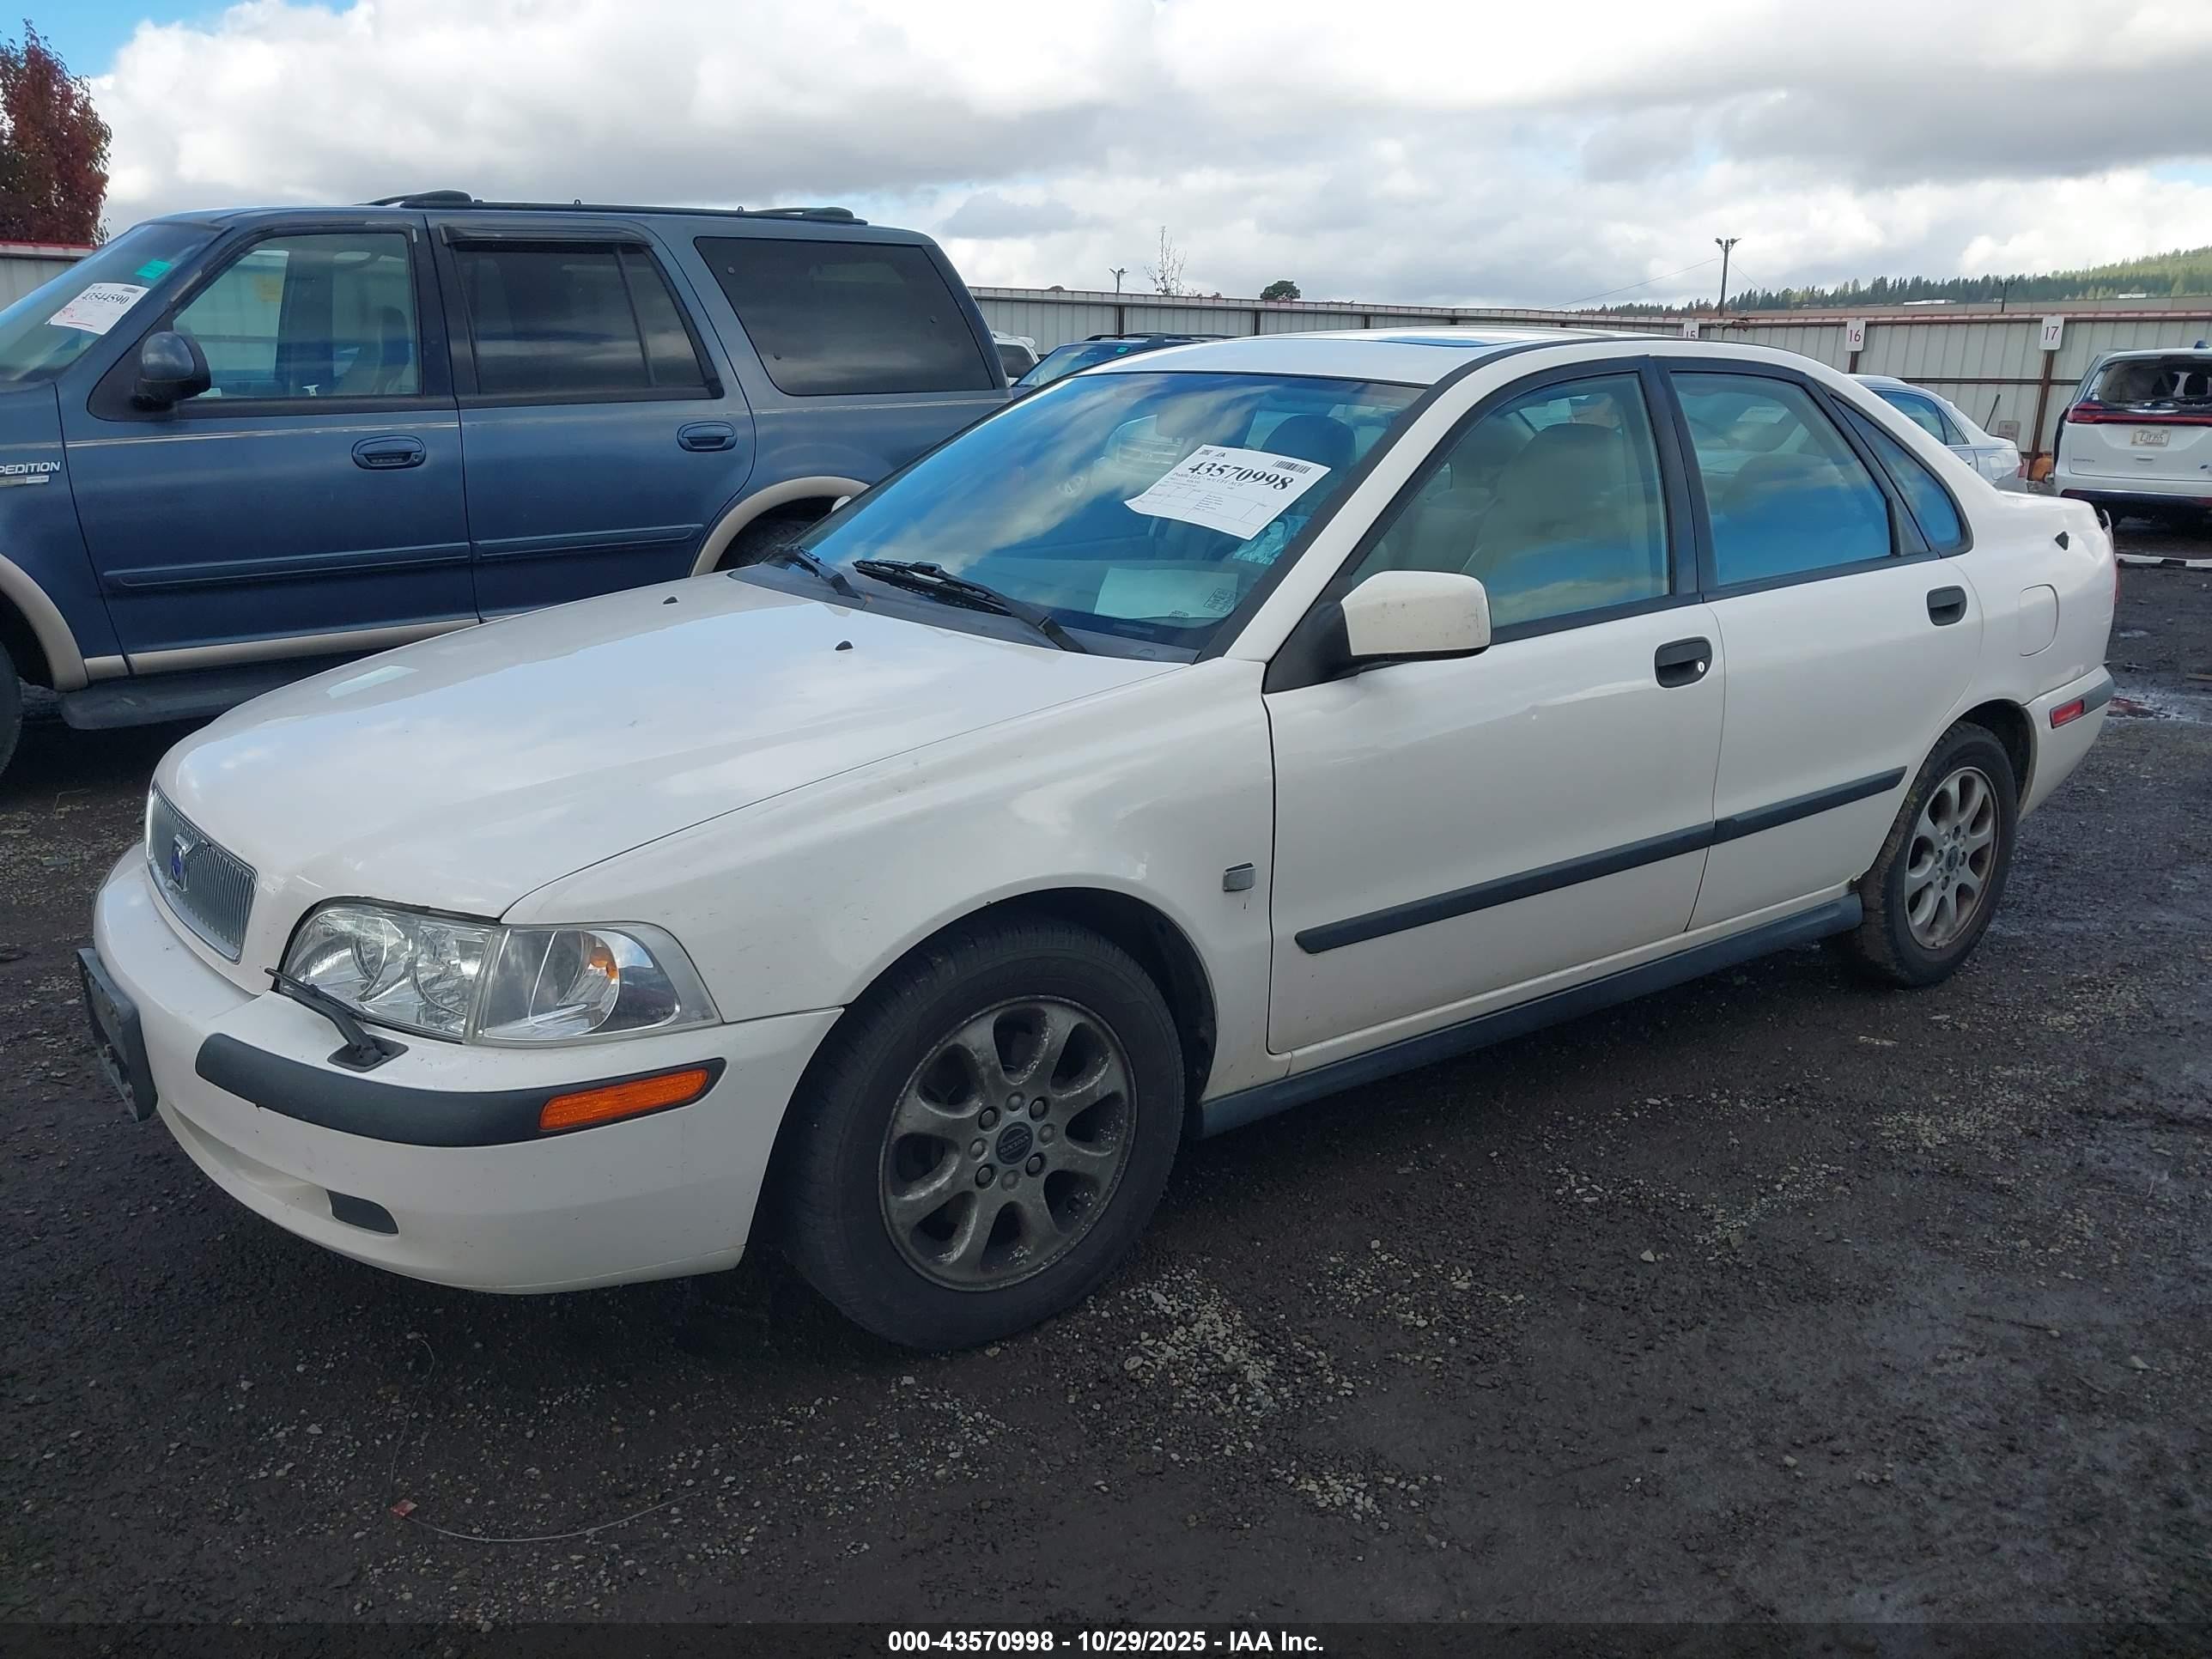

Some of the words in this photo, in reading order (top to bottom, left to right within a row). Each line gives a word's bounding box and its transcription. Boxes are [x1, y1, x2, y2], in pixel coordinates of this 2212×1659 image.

[1850, 329, 1862, 343] 16
[2045, 325, 2059, 340] 17
[1188, 461, 1294, 490] 43570998
